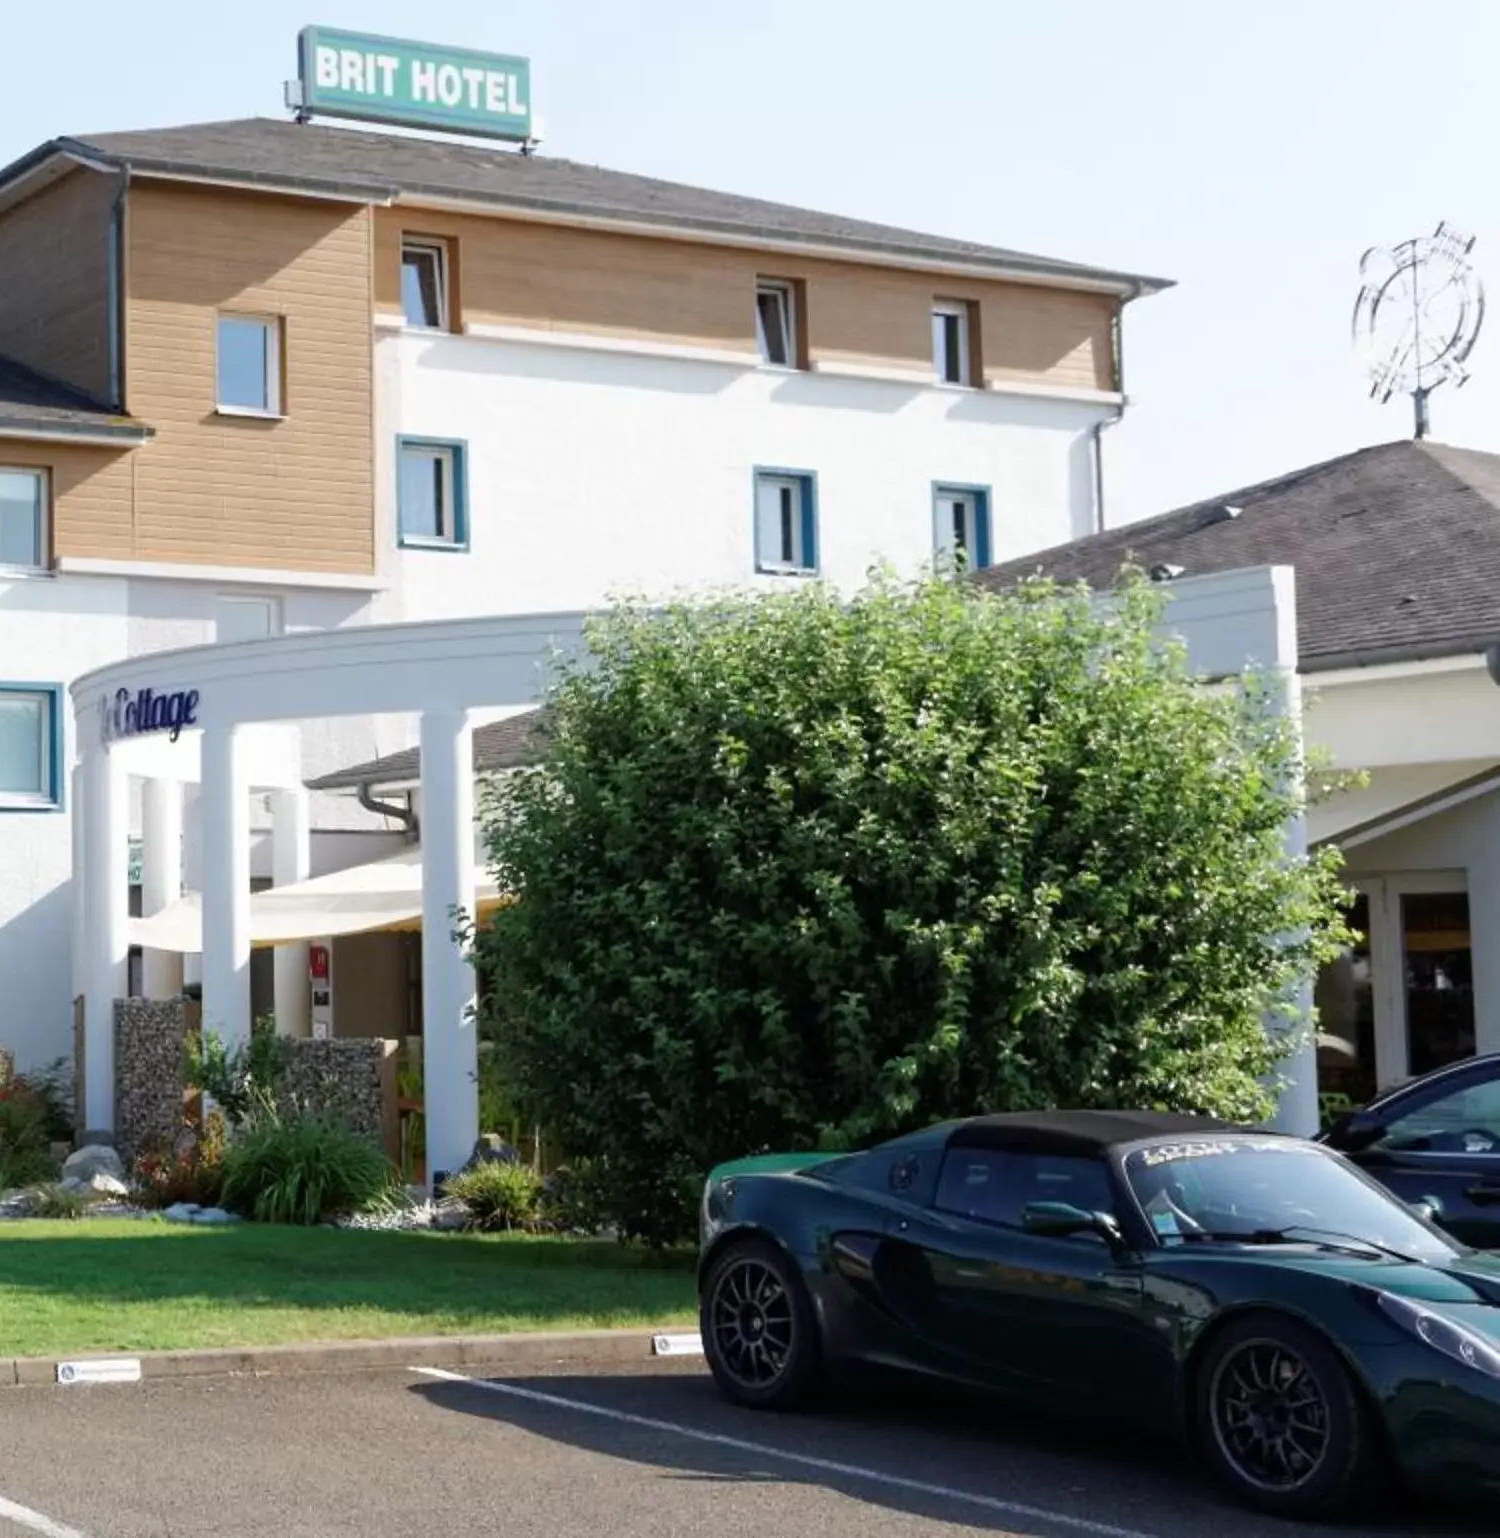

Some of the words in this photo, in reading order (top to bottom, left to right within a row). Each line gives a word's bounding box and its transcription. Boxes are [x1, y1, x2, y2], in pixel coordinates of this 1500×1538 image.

[316, 46, 398, 96] BRIT
[412, 60, 527, 114] HOTEL
[113, 688, 199, 743] Cottage
